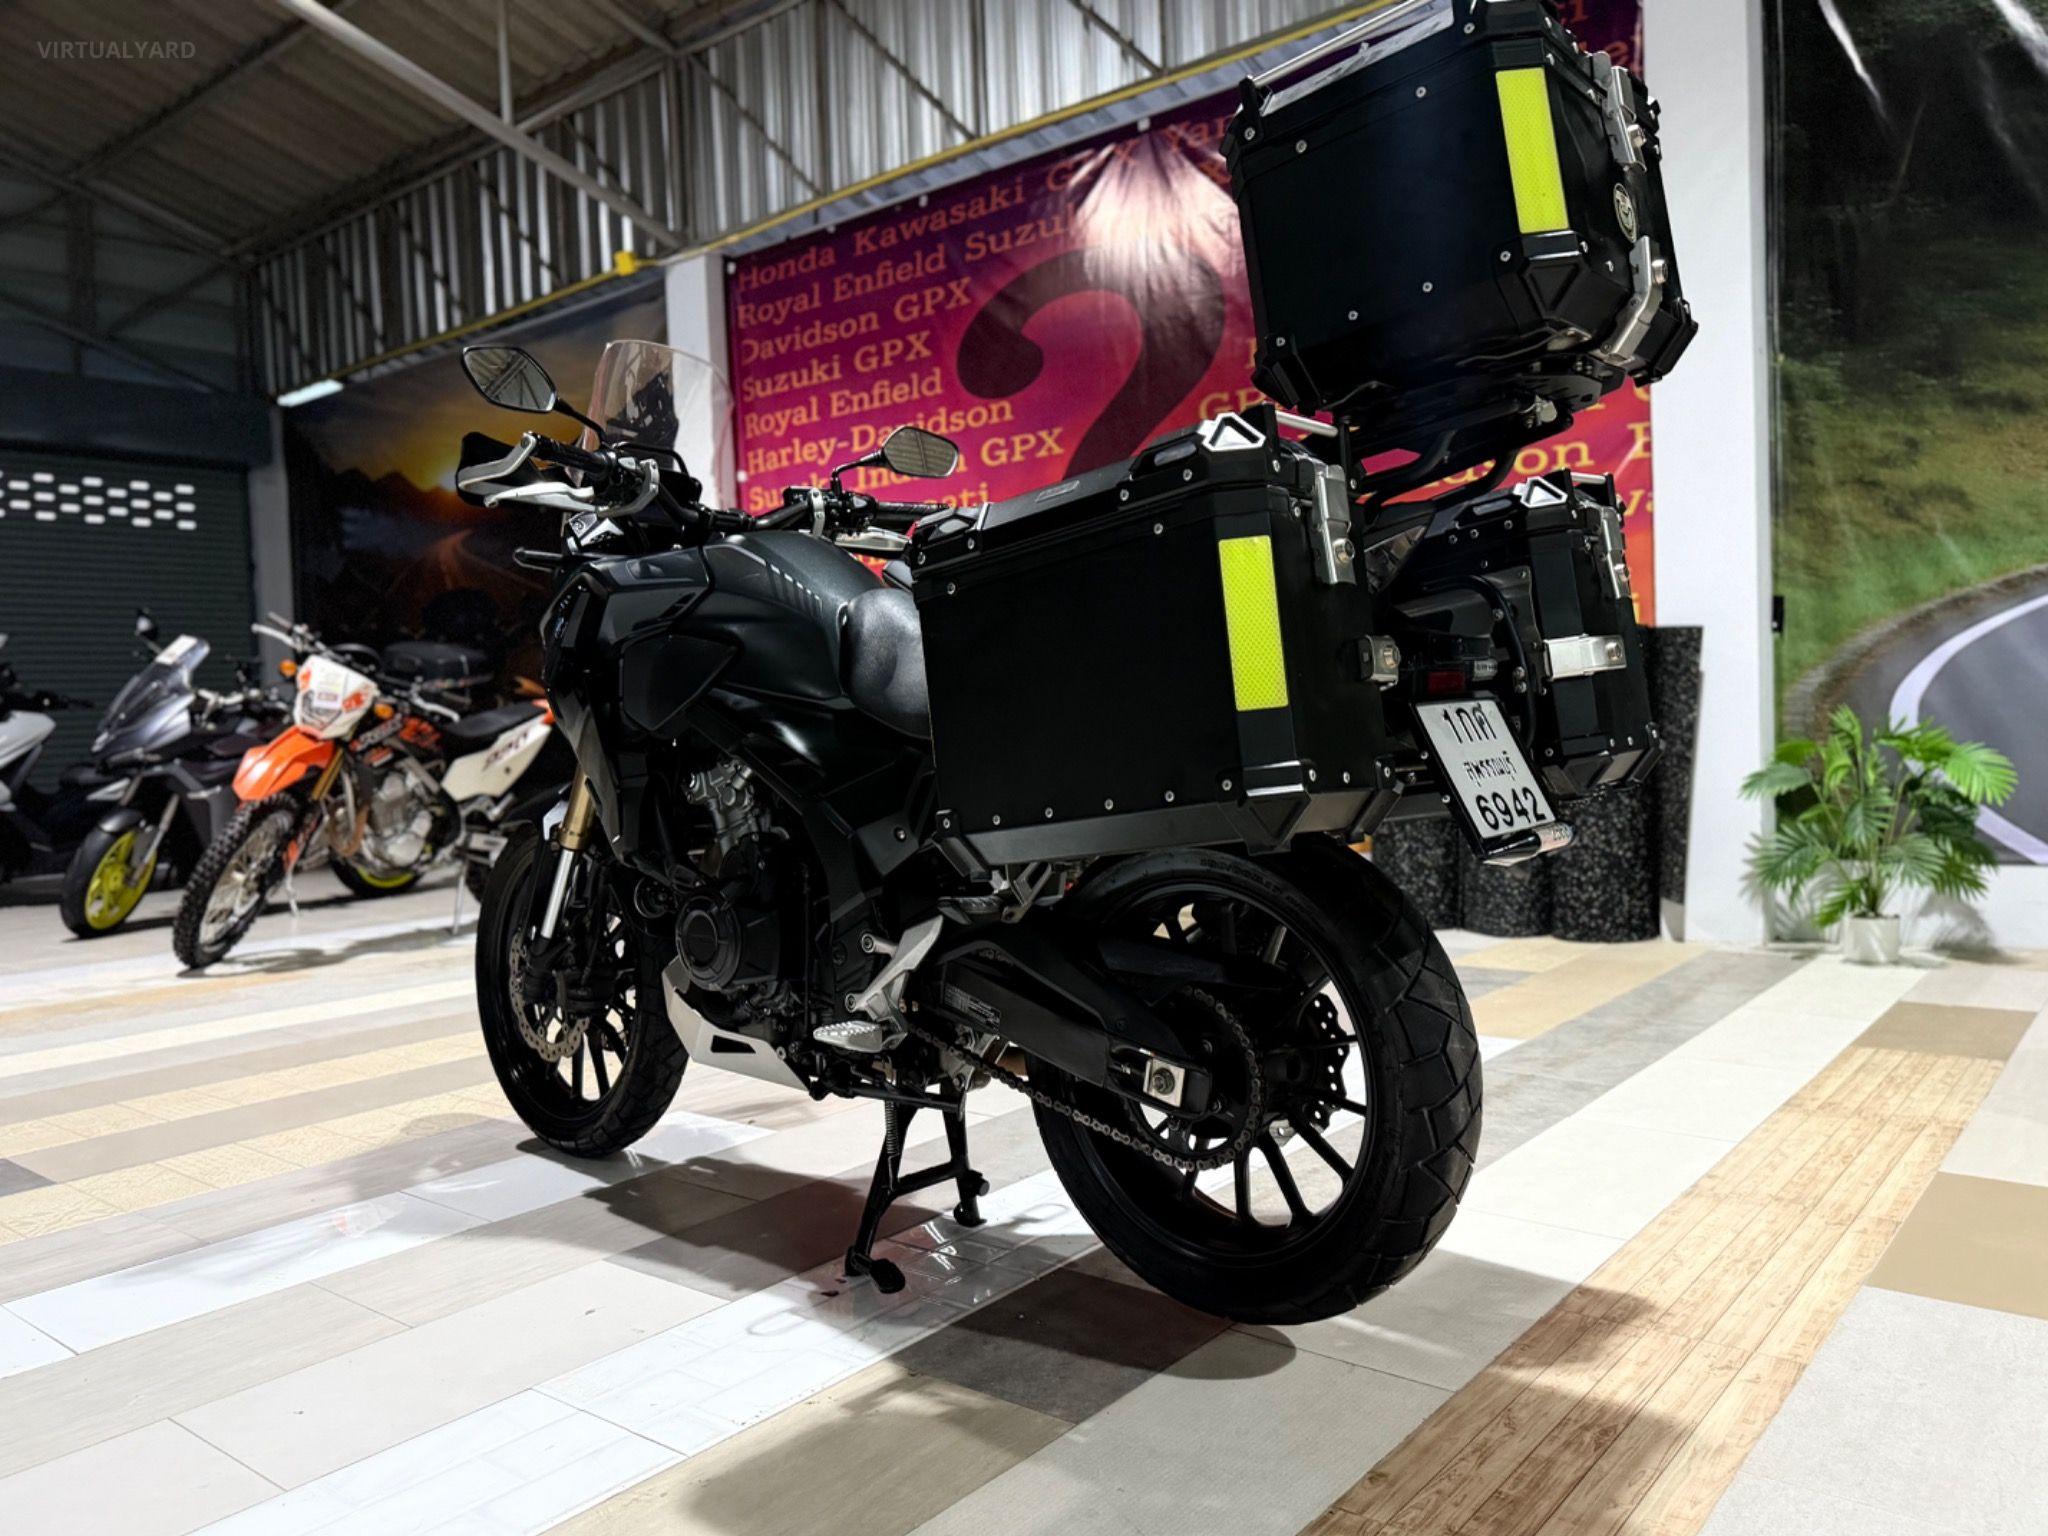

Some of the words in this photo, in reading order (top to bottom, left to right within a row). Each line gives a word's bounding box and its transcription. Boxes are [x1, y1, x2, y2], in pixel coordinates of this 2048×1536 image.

[738, 246, 836, 292] Honda
[853, 176, 1026, 257] Kawasaki
[737, 282, 822, 329] Royal
[834, 243, 947, 302] Enfield
[894, 276, 972, 322] GPX
[742, 354, 842, 402] Suzuki
[854, 330, 932, 373] GPX
[745, 395, 820, 438] Royal
[830, 367, 943, 418] Enfield
[747, 400, 1014, 476] Harley-Daidson
[980, 427, 1065, 468] GPX
[1475, 786, 1547, 831] 6942
